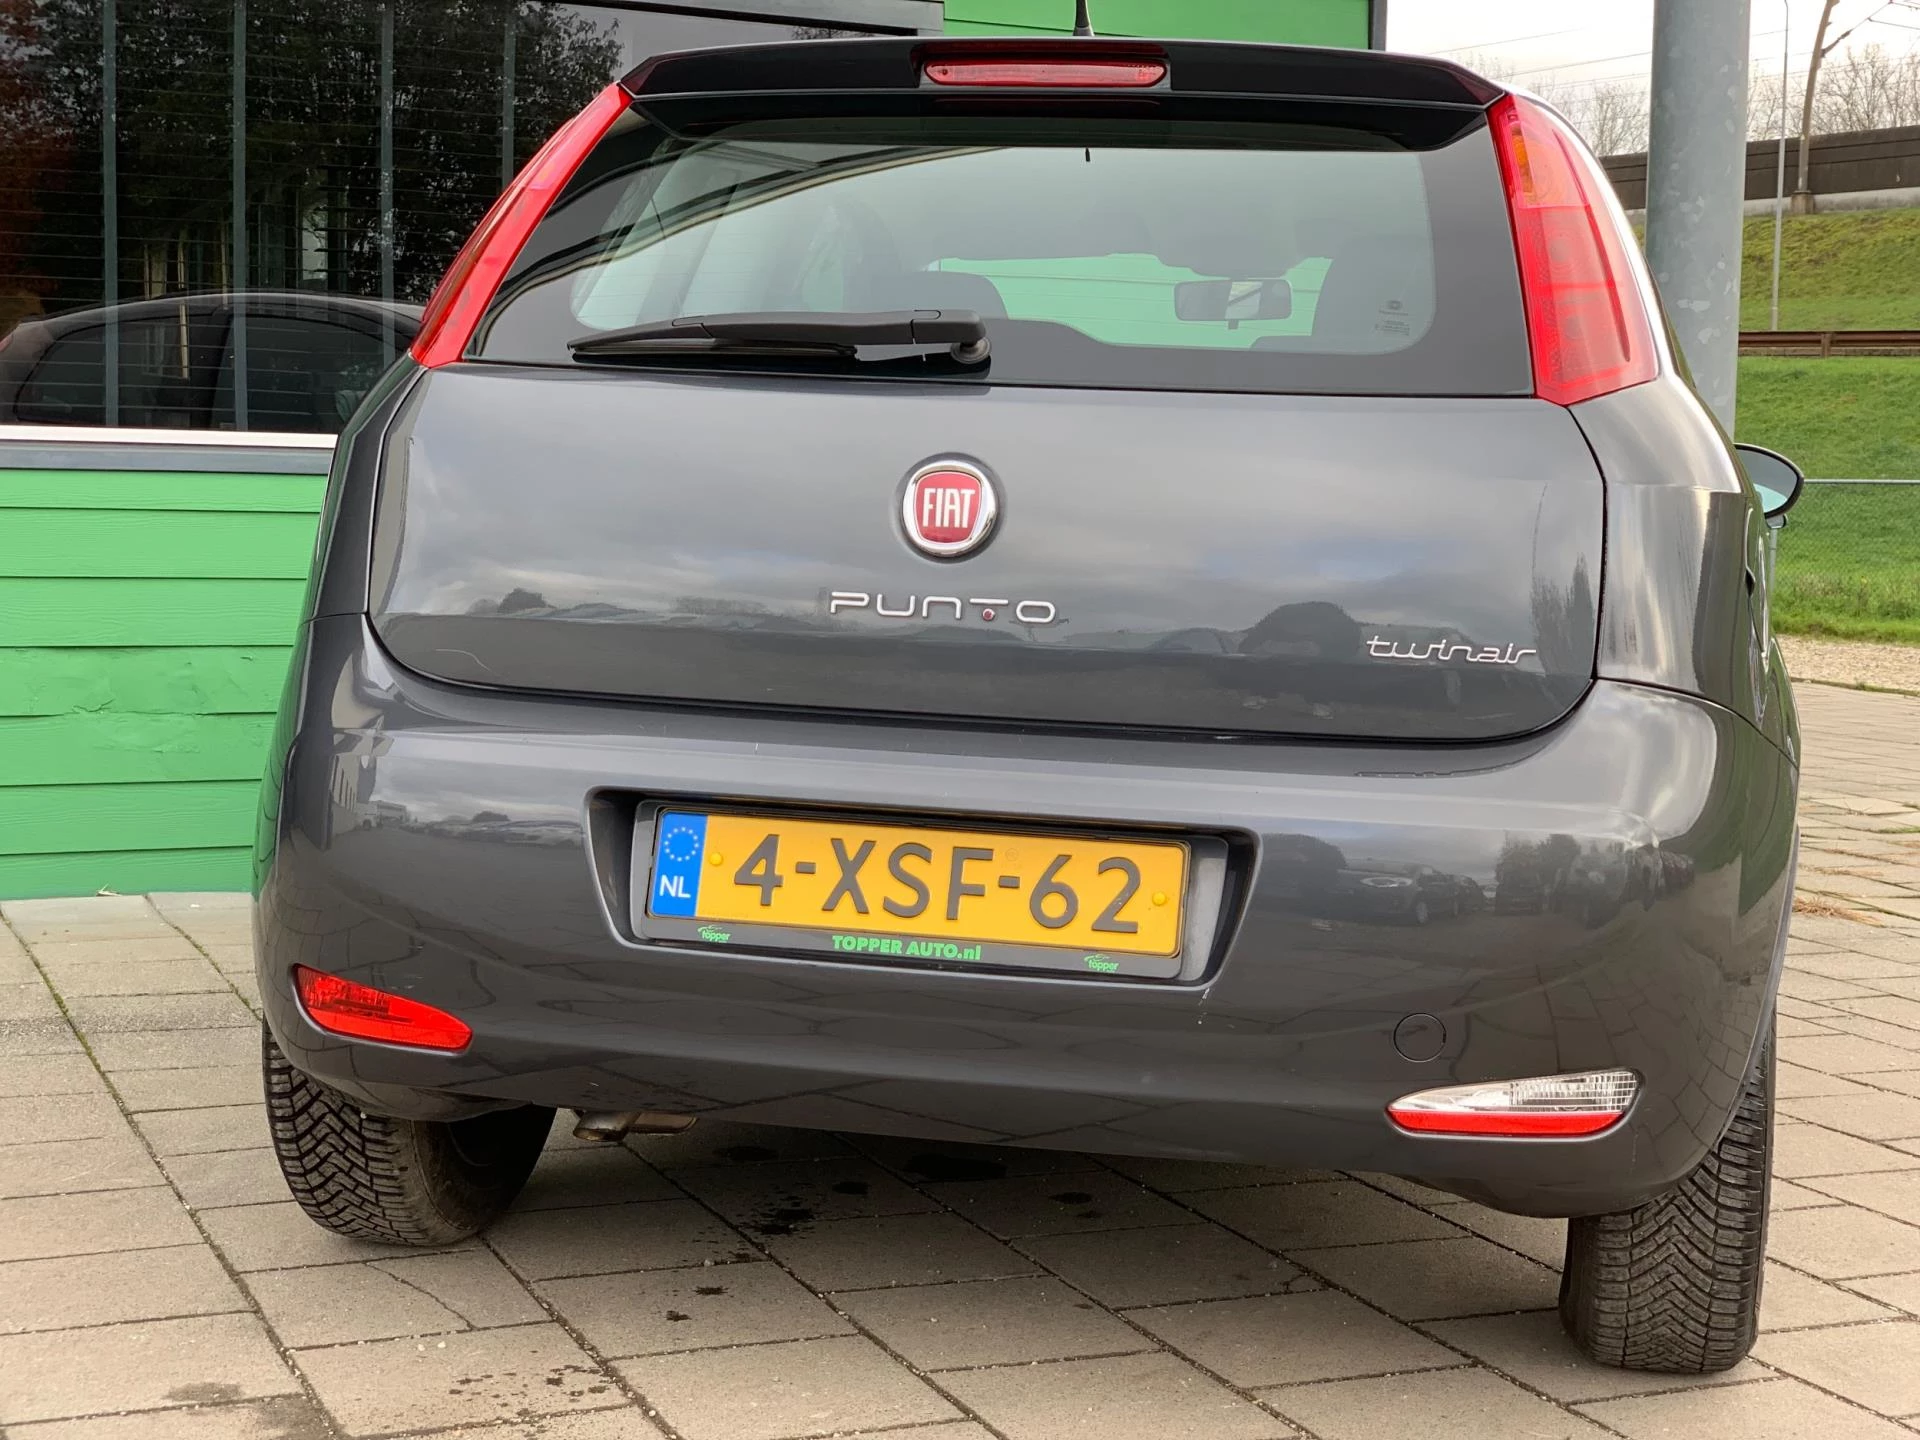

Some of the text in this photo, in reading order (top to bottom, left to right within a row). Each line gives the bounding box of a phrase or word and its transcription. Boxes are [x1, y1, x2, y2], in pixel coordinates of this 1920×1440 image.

[922, 487, 976, 529] FIAT
[830, 591, 1056, 624] PUNTO
[658, 875, 691, 899] NL
[733, 833, 1142, 935] 4-XSF-62
[832, 934, 982, 961] TOPPER AUTO.nl
